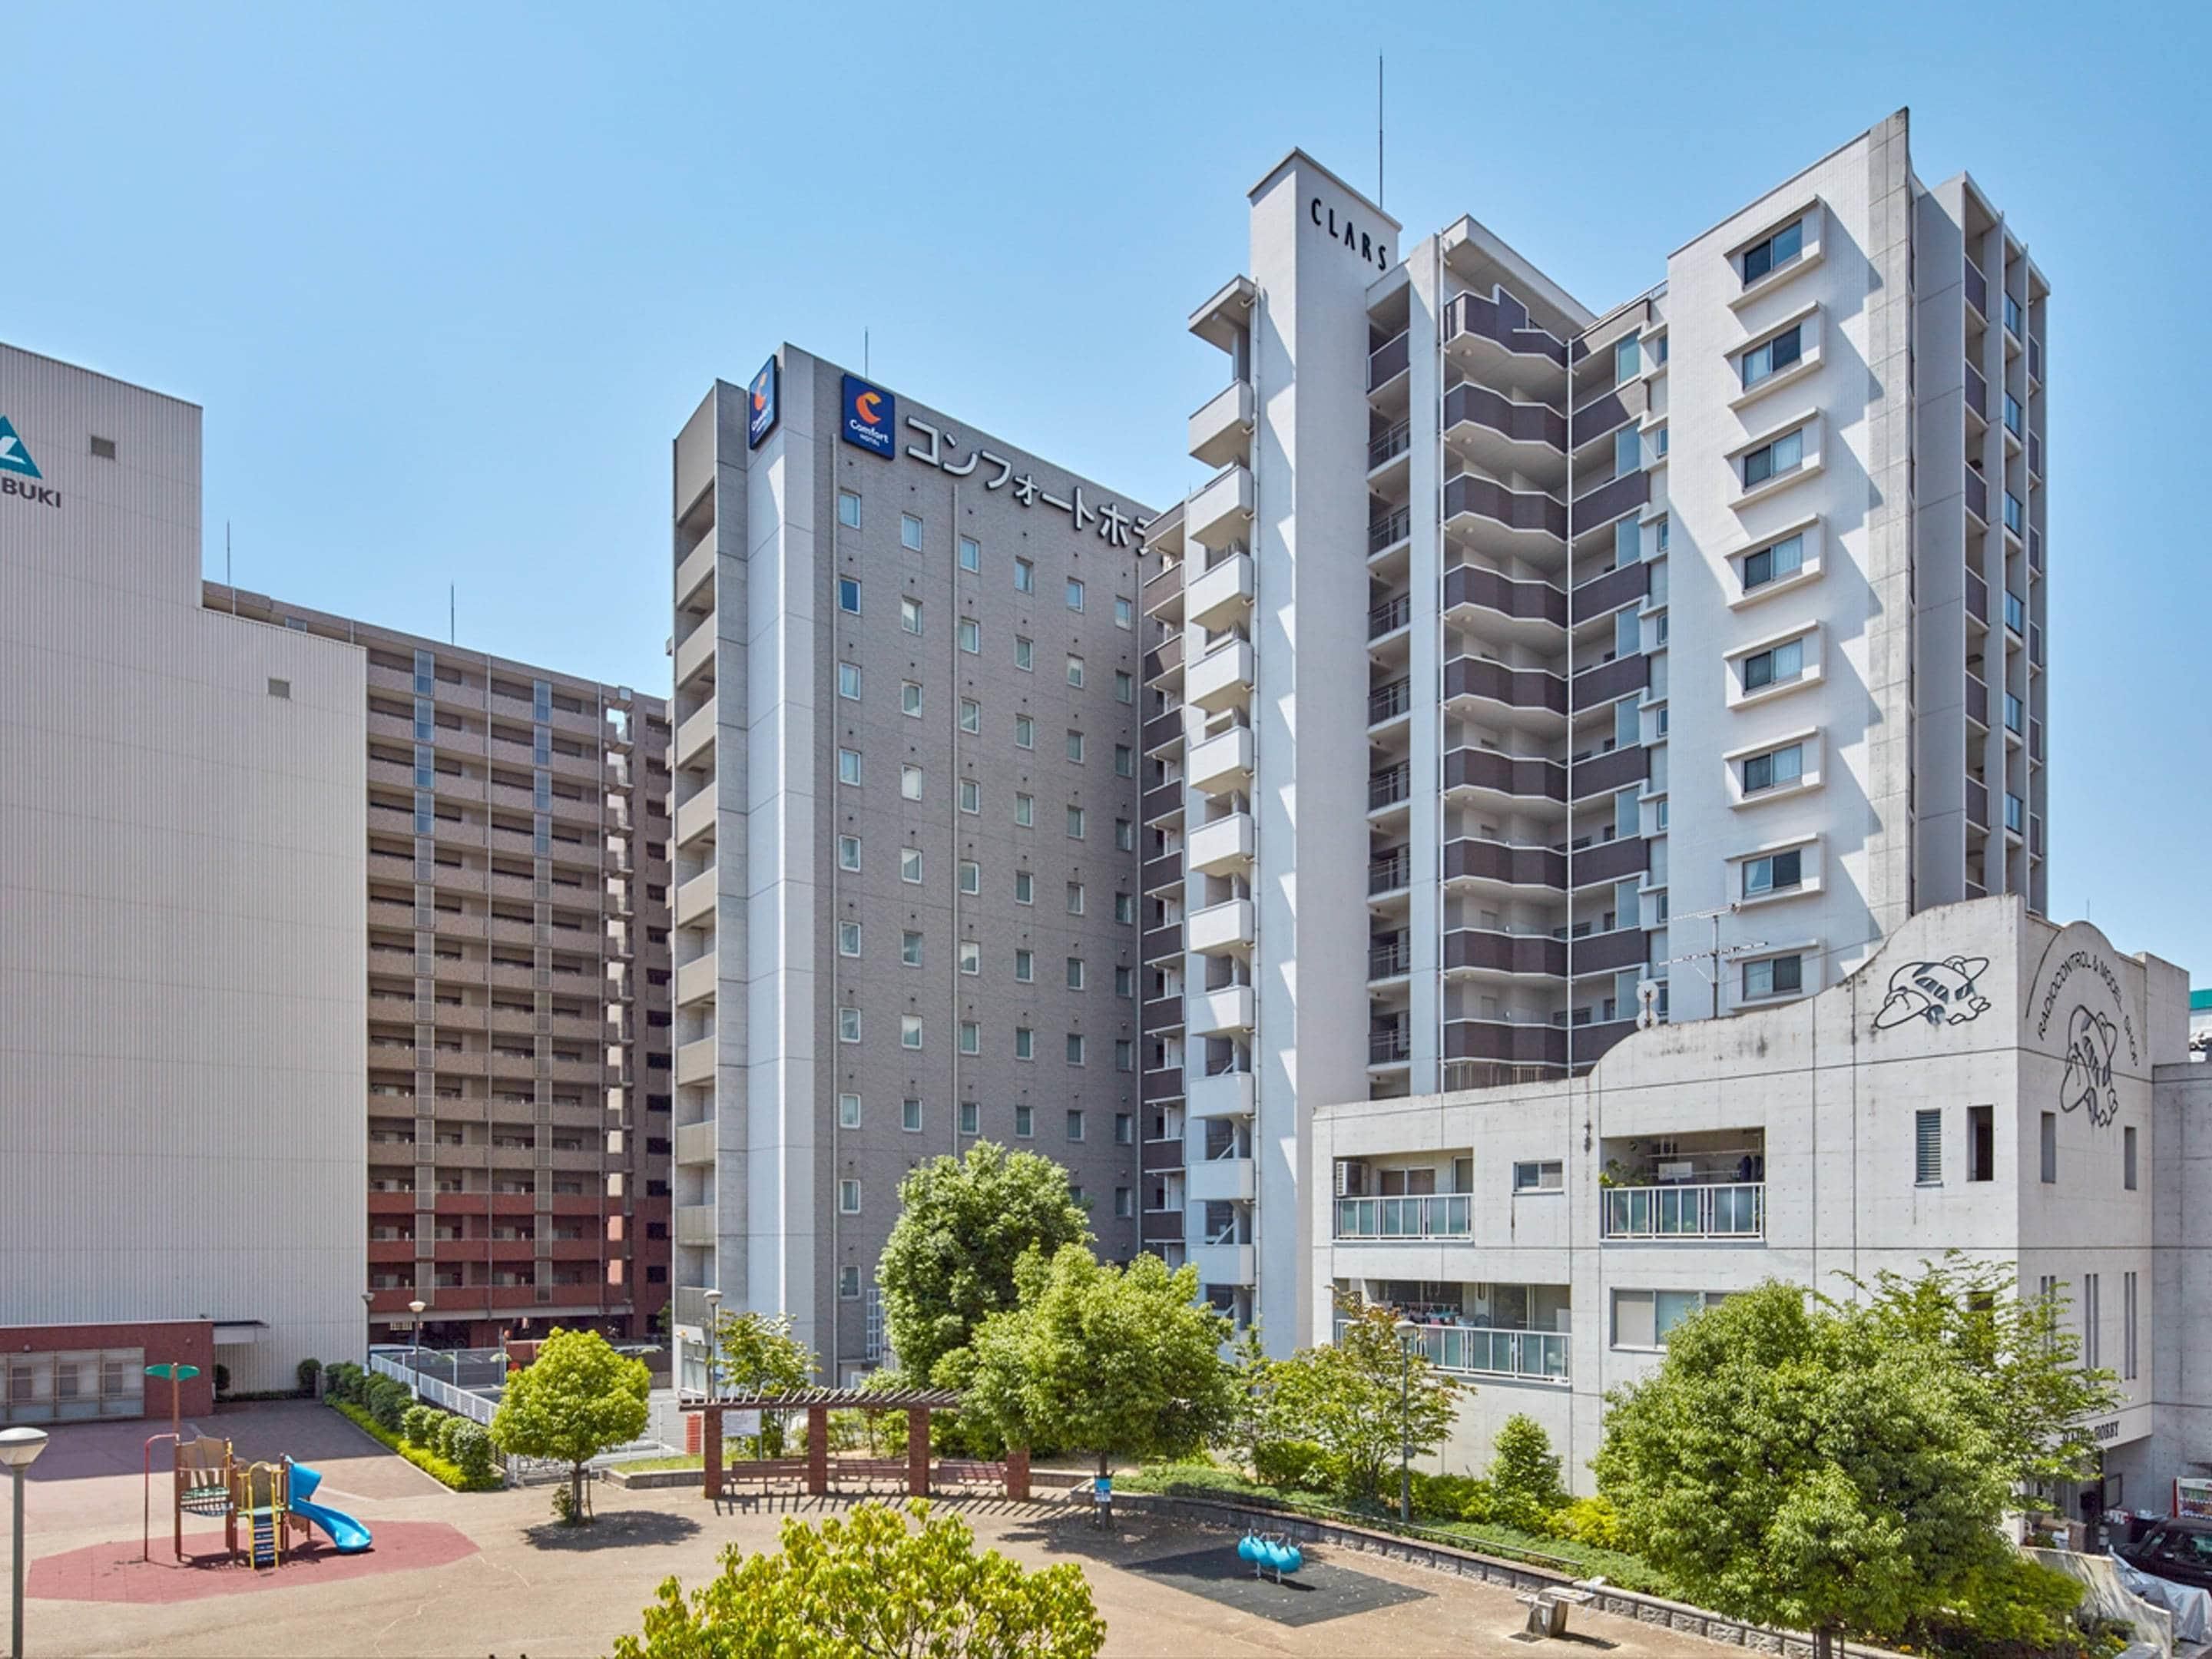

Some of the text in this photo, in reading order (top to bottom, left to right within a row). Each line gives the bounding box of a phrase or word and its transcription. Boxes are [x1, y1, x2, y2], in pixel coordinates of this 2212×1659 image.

[1311, 197, 1387, 271] CLARS
[849, 419, 889, 444] Comfort
[2, 476, 61, 508] BUKI
